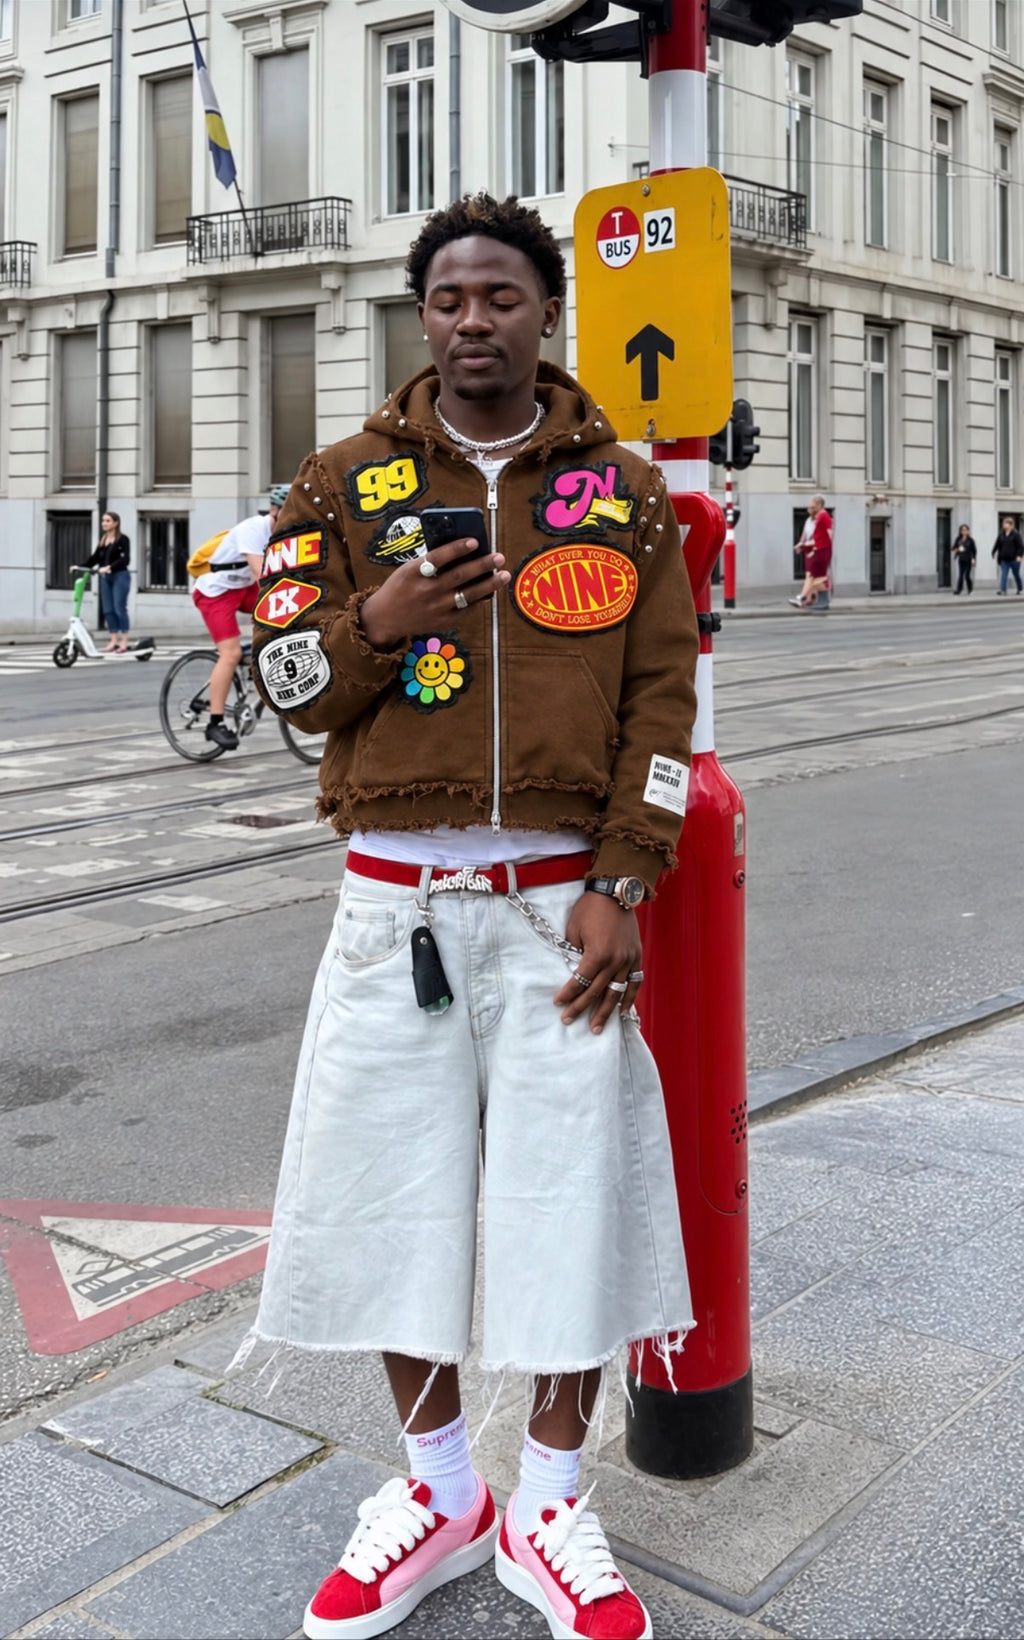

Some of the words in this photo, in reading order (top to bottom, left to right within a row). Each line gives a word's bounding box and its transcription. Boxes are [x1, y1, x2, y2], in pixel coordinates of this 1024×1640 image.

[611, 211, 623, 234] T
[646, 216, 673, 247] 92
[605, 239, 631, 258] BUS
[356, 458, 419, 512] 99
[530, 555, 556, 577] WHAT
[587, 550, 607, 561] YOU
[535, 560, 625, 613] NINE
[267, 585, 300, 620] IX
[534, 607, 566, 624] DON'T
[567, 615, 592, 625] LOSE
[266, 646, 284, 664] THE
[286, 640, 309, 653] NINE
[283, 658, 298, 680] 9
